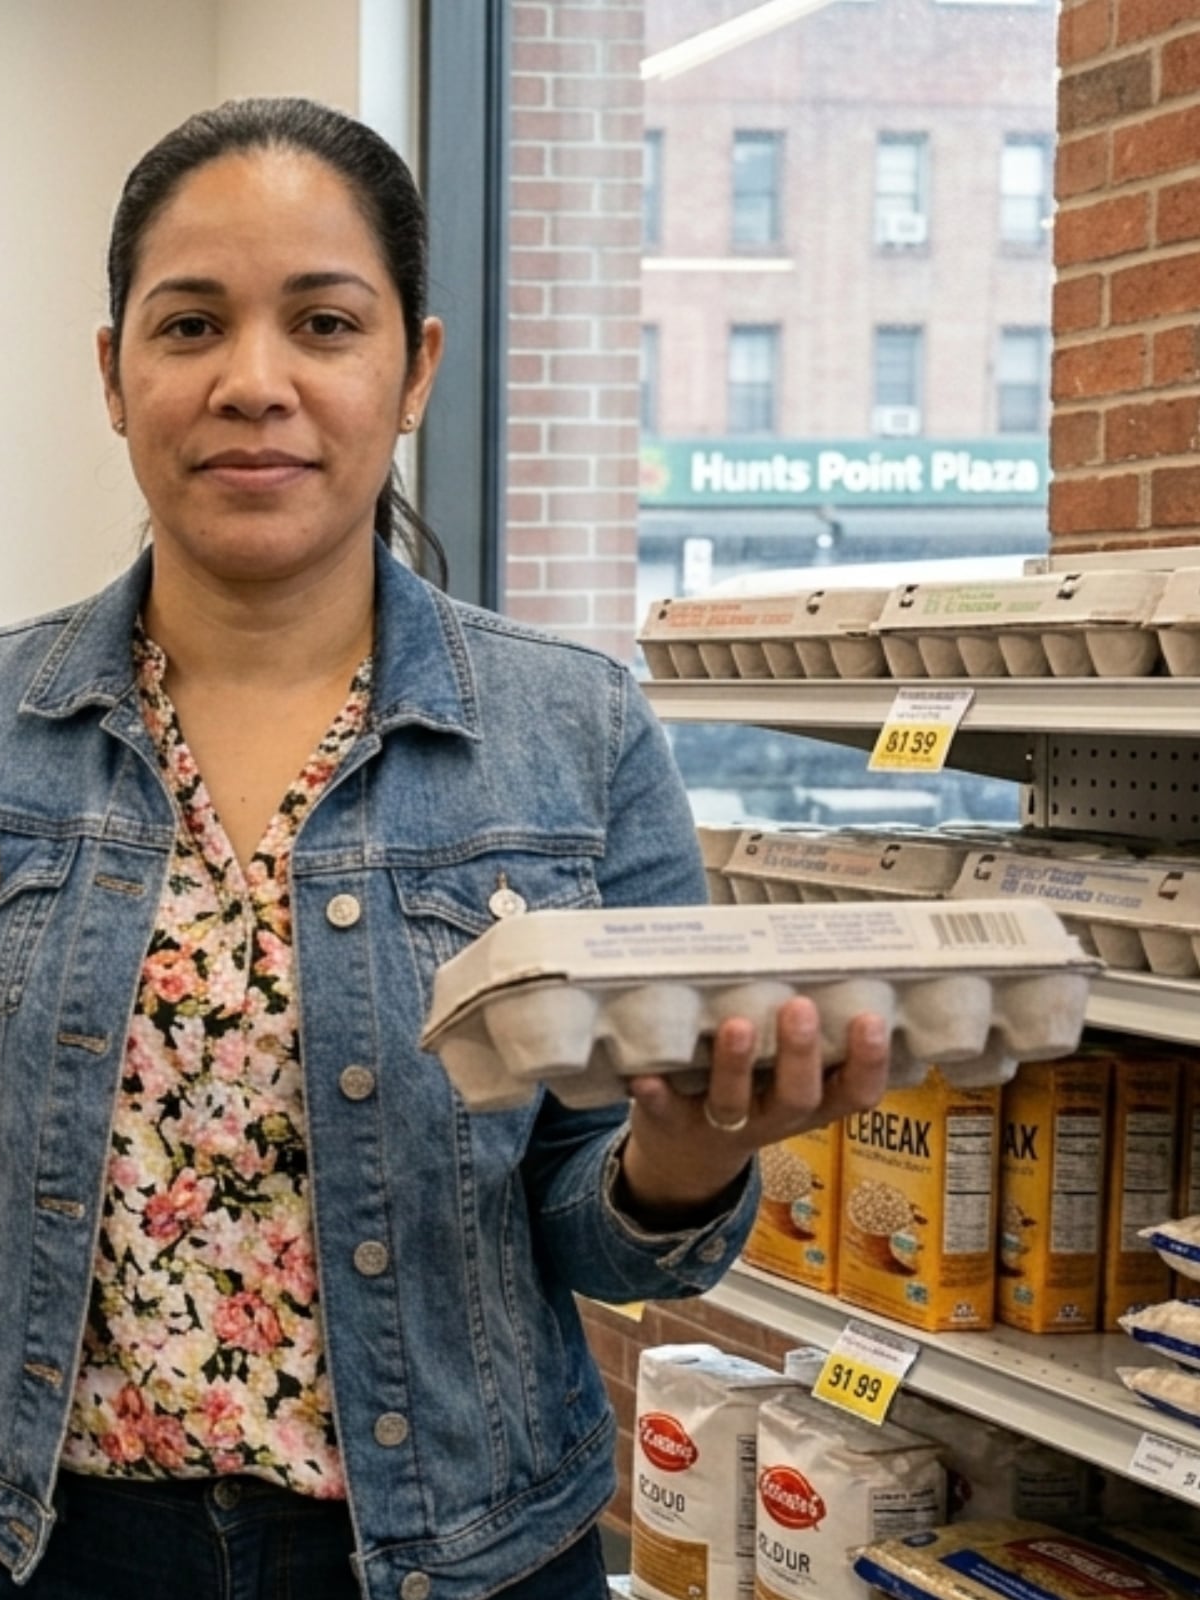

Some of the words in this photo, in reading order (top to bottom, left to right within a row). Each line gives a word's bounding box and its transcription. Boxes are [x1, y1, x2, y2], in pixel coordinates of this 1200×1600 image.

[691, 450, 811, 493] Hunts
[817, 450, 923, 493] Point
[931, 450, 1039, 494] Plaza
